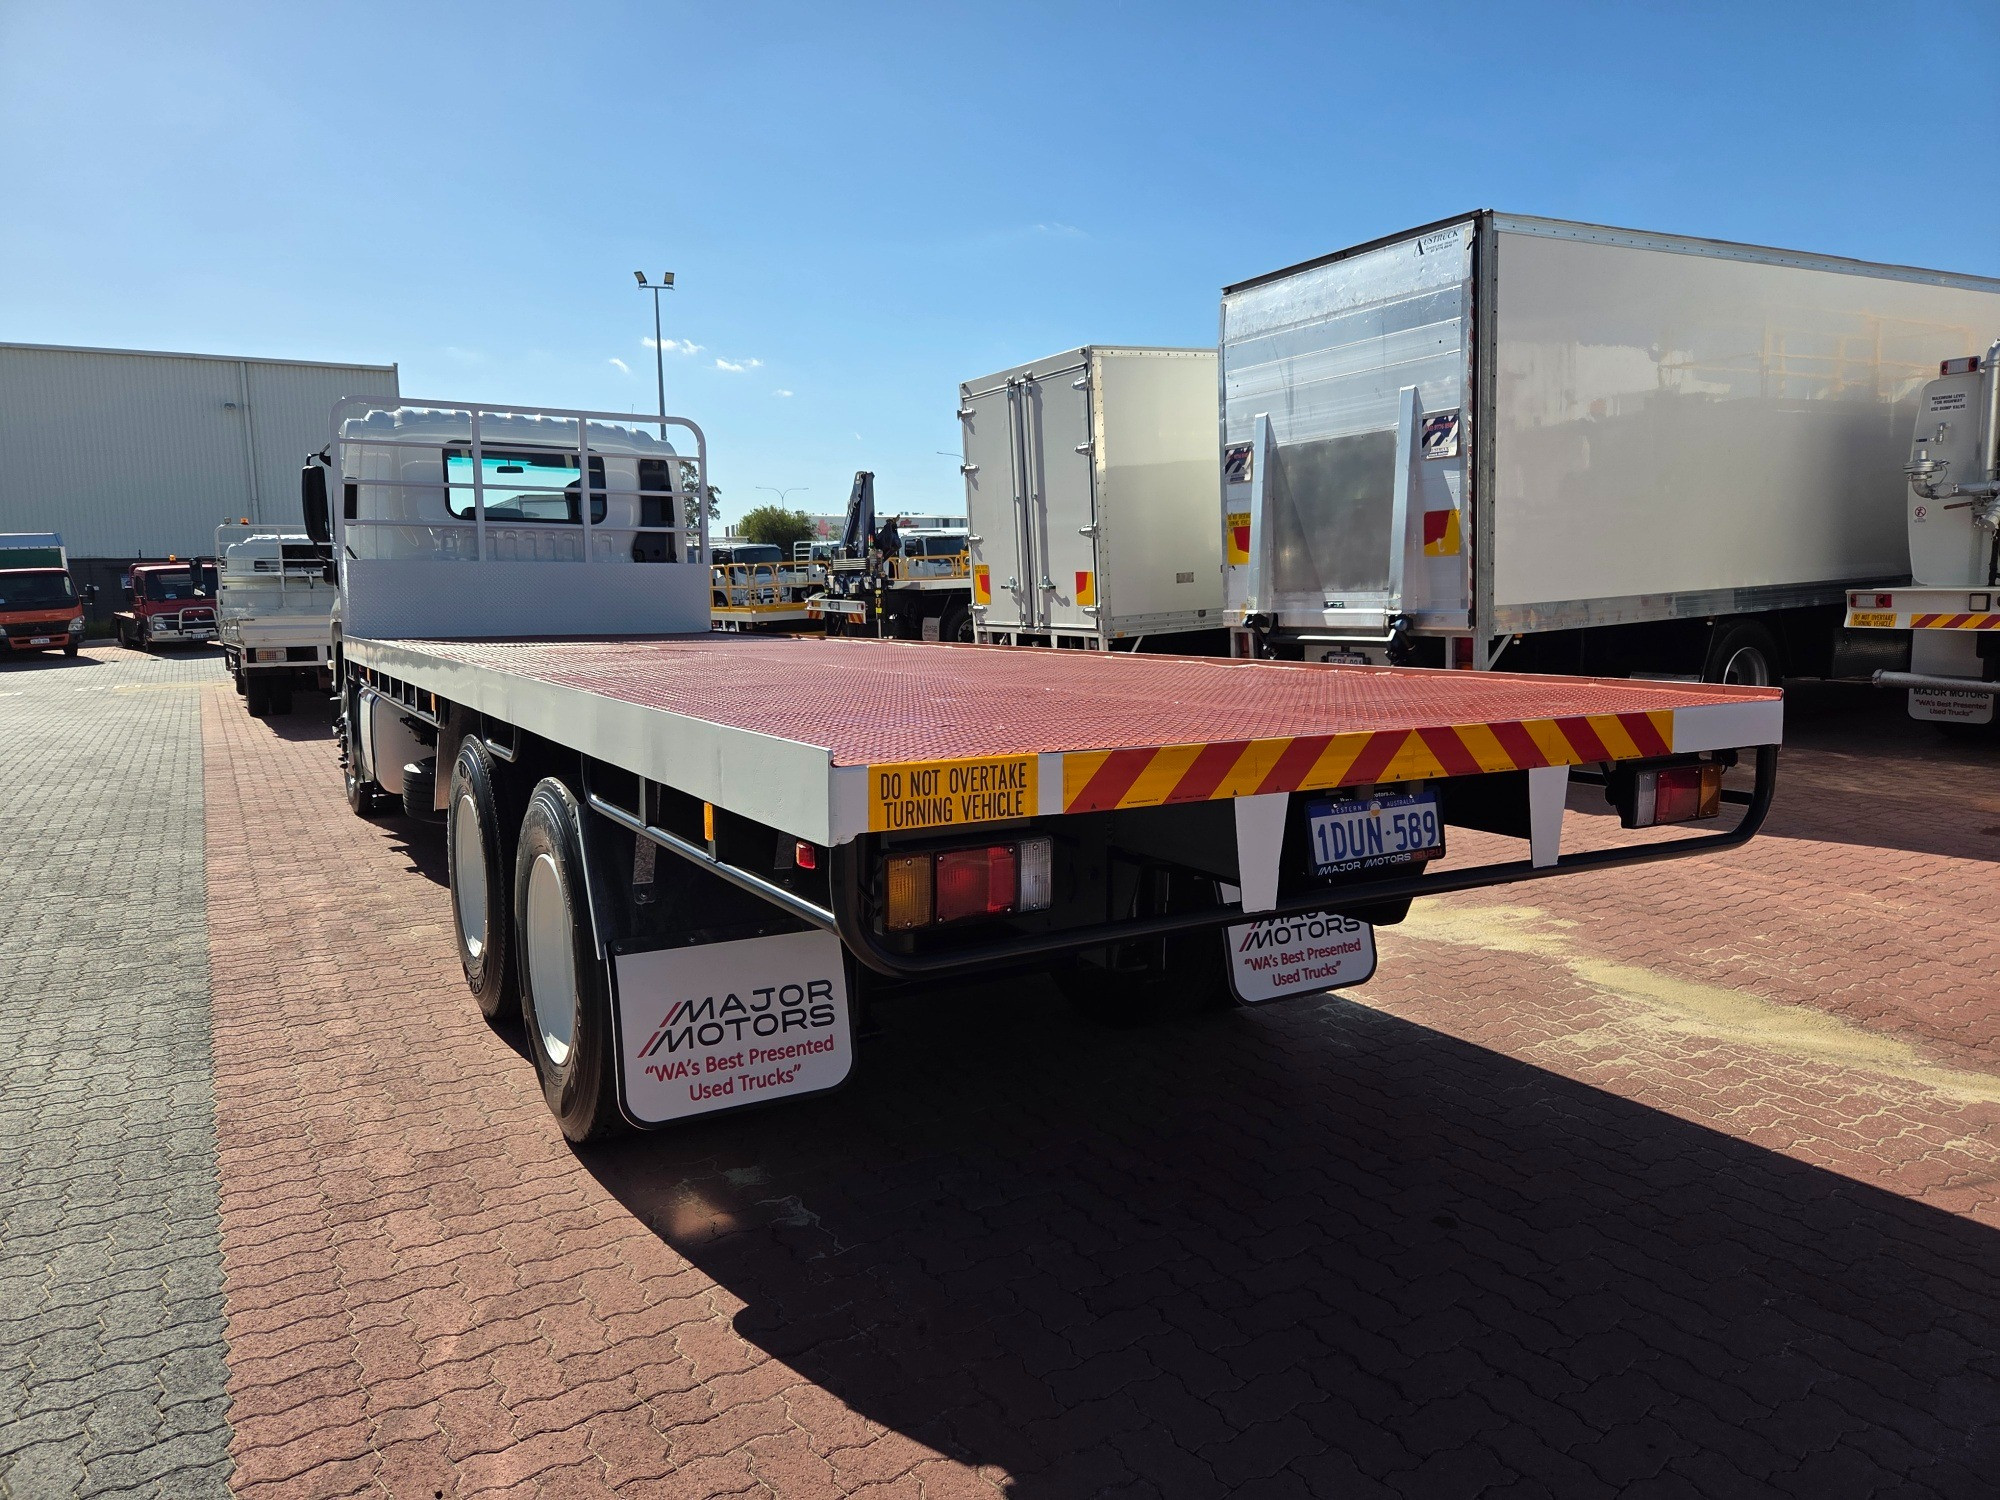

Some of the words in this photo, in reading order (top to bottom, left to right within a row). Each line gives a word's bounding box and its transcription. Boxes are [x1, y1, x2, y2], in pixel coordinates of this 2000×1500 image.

[1913, 688, 1948, 696] MAJOR
[1949, 690, 1990, 699] MOTORS
[1953, 701, 1987, 710] Presented
[880, 772, 902, 801] DO
[910, 769, 941, 798] NOT
[949, 762, 1028, 795] OVERTAKE
[883, 796, 954, 829] TURNING
[961, 789, 1025, 822] VEHICLE
[1331, 804, 1363, 815] WESTERN
[1386, 797, 1416, 807] AUSTRALIA
[1318, 861, 1361, 876] MAJOR
[1363, 852, 1412, 868] MOTORS
[1238, 916, 1361, 953] MOTORS
[1280, 950, 1306, 966] Best
[1307, 937, 1362, 961] Presented
[1272, 967, 1301, 987] Used
[658, 979, 834, 1028] MAJOR
[636, 1003, 836, 1059] MOTORS
[705, 1051, 745, 1074] Best
[749, 1033, 835, 1066] Presented
[689, 1076, 735, 1102] Used
